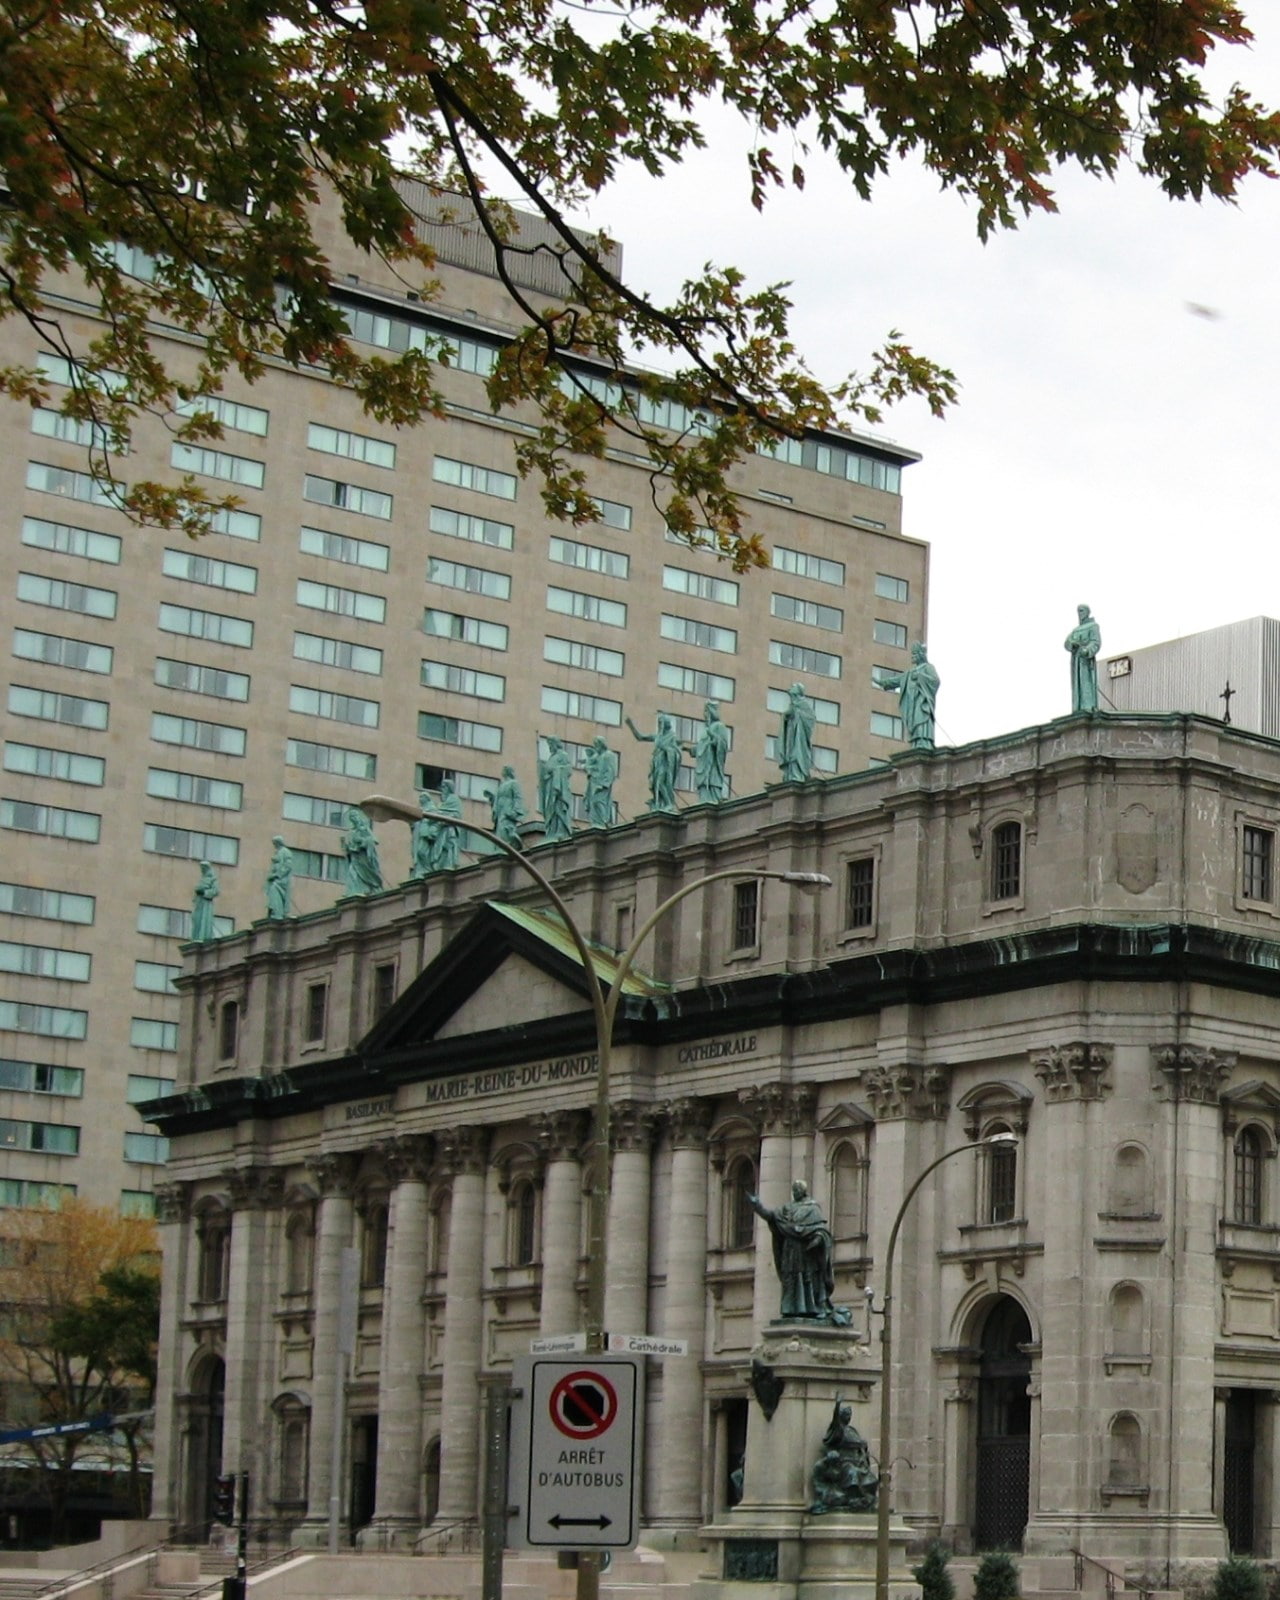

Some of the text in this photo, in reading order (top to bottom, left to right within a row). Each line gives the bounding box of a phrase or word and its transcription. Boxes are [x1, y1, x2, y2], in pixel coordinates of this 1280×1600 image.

[679, 1036, 757, 1063] CATHÉDRALE
[425, 1054, 599, 1102] MARIE-REINE-DU-MONDE
[629, 1341, 682, 1354] Cathédrale
[558, 1446, 605, 1464] ARRÊT
[539, 1472, 624, 1487] D'AUTOBUS
